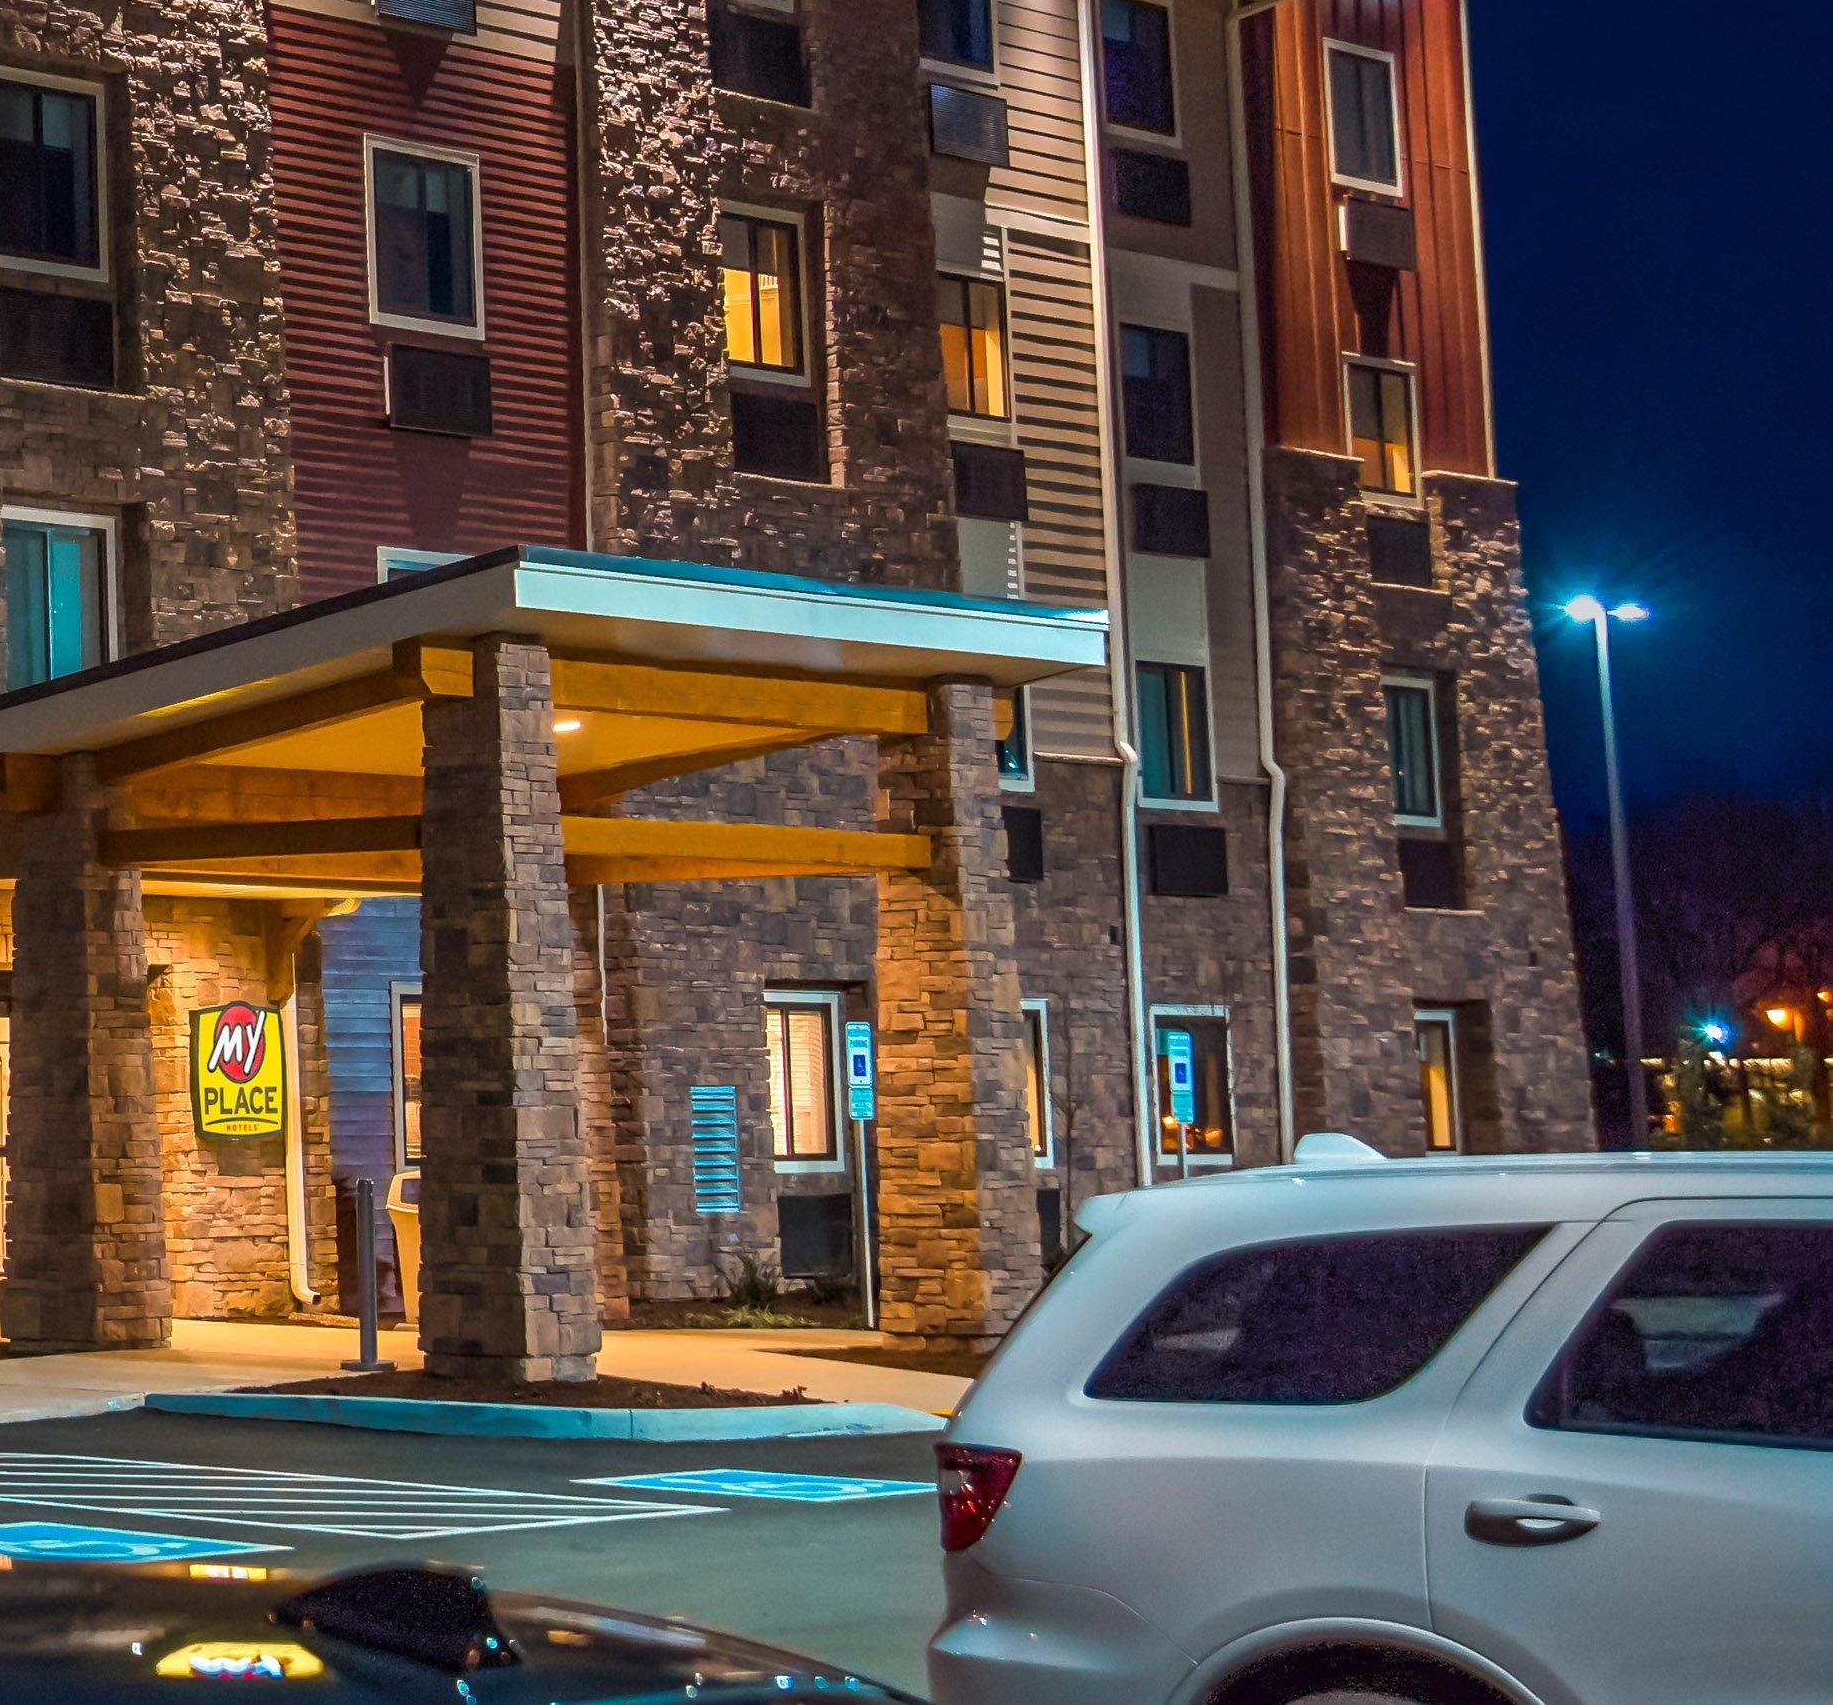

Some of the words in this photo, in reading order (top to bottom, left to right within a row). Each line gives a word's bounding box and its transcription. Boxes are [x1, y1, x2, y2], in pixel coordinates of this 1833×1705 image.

[208, 1011, 265, 1074] MY
[204, 1086, 278, 1114] PLACE
[226, 1123, 258, 1131] HOTELS
